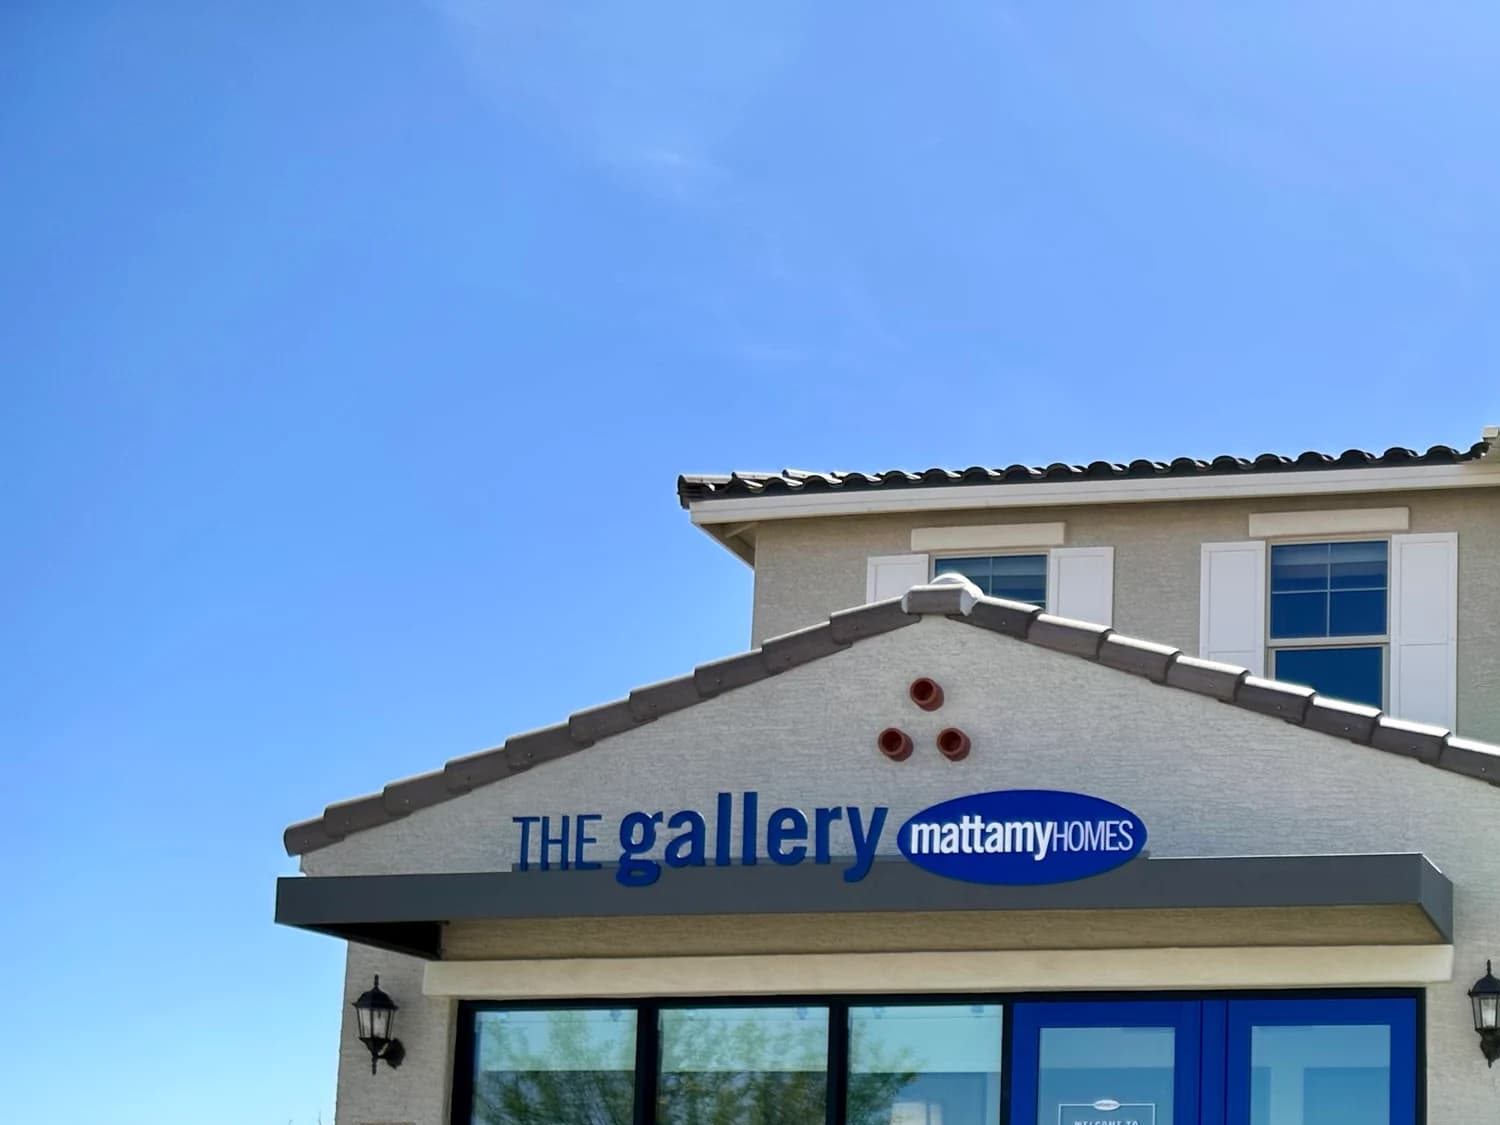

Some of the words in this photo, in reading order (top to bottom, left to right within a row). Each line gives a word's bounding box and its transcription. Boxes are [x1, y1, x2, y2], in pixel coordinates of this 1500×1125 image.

[511, 813, 603, 872] THE
[615, 791, 889, 888] gallery
[910, 813, 1134, 862] mattamyHOMES
